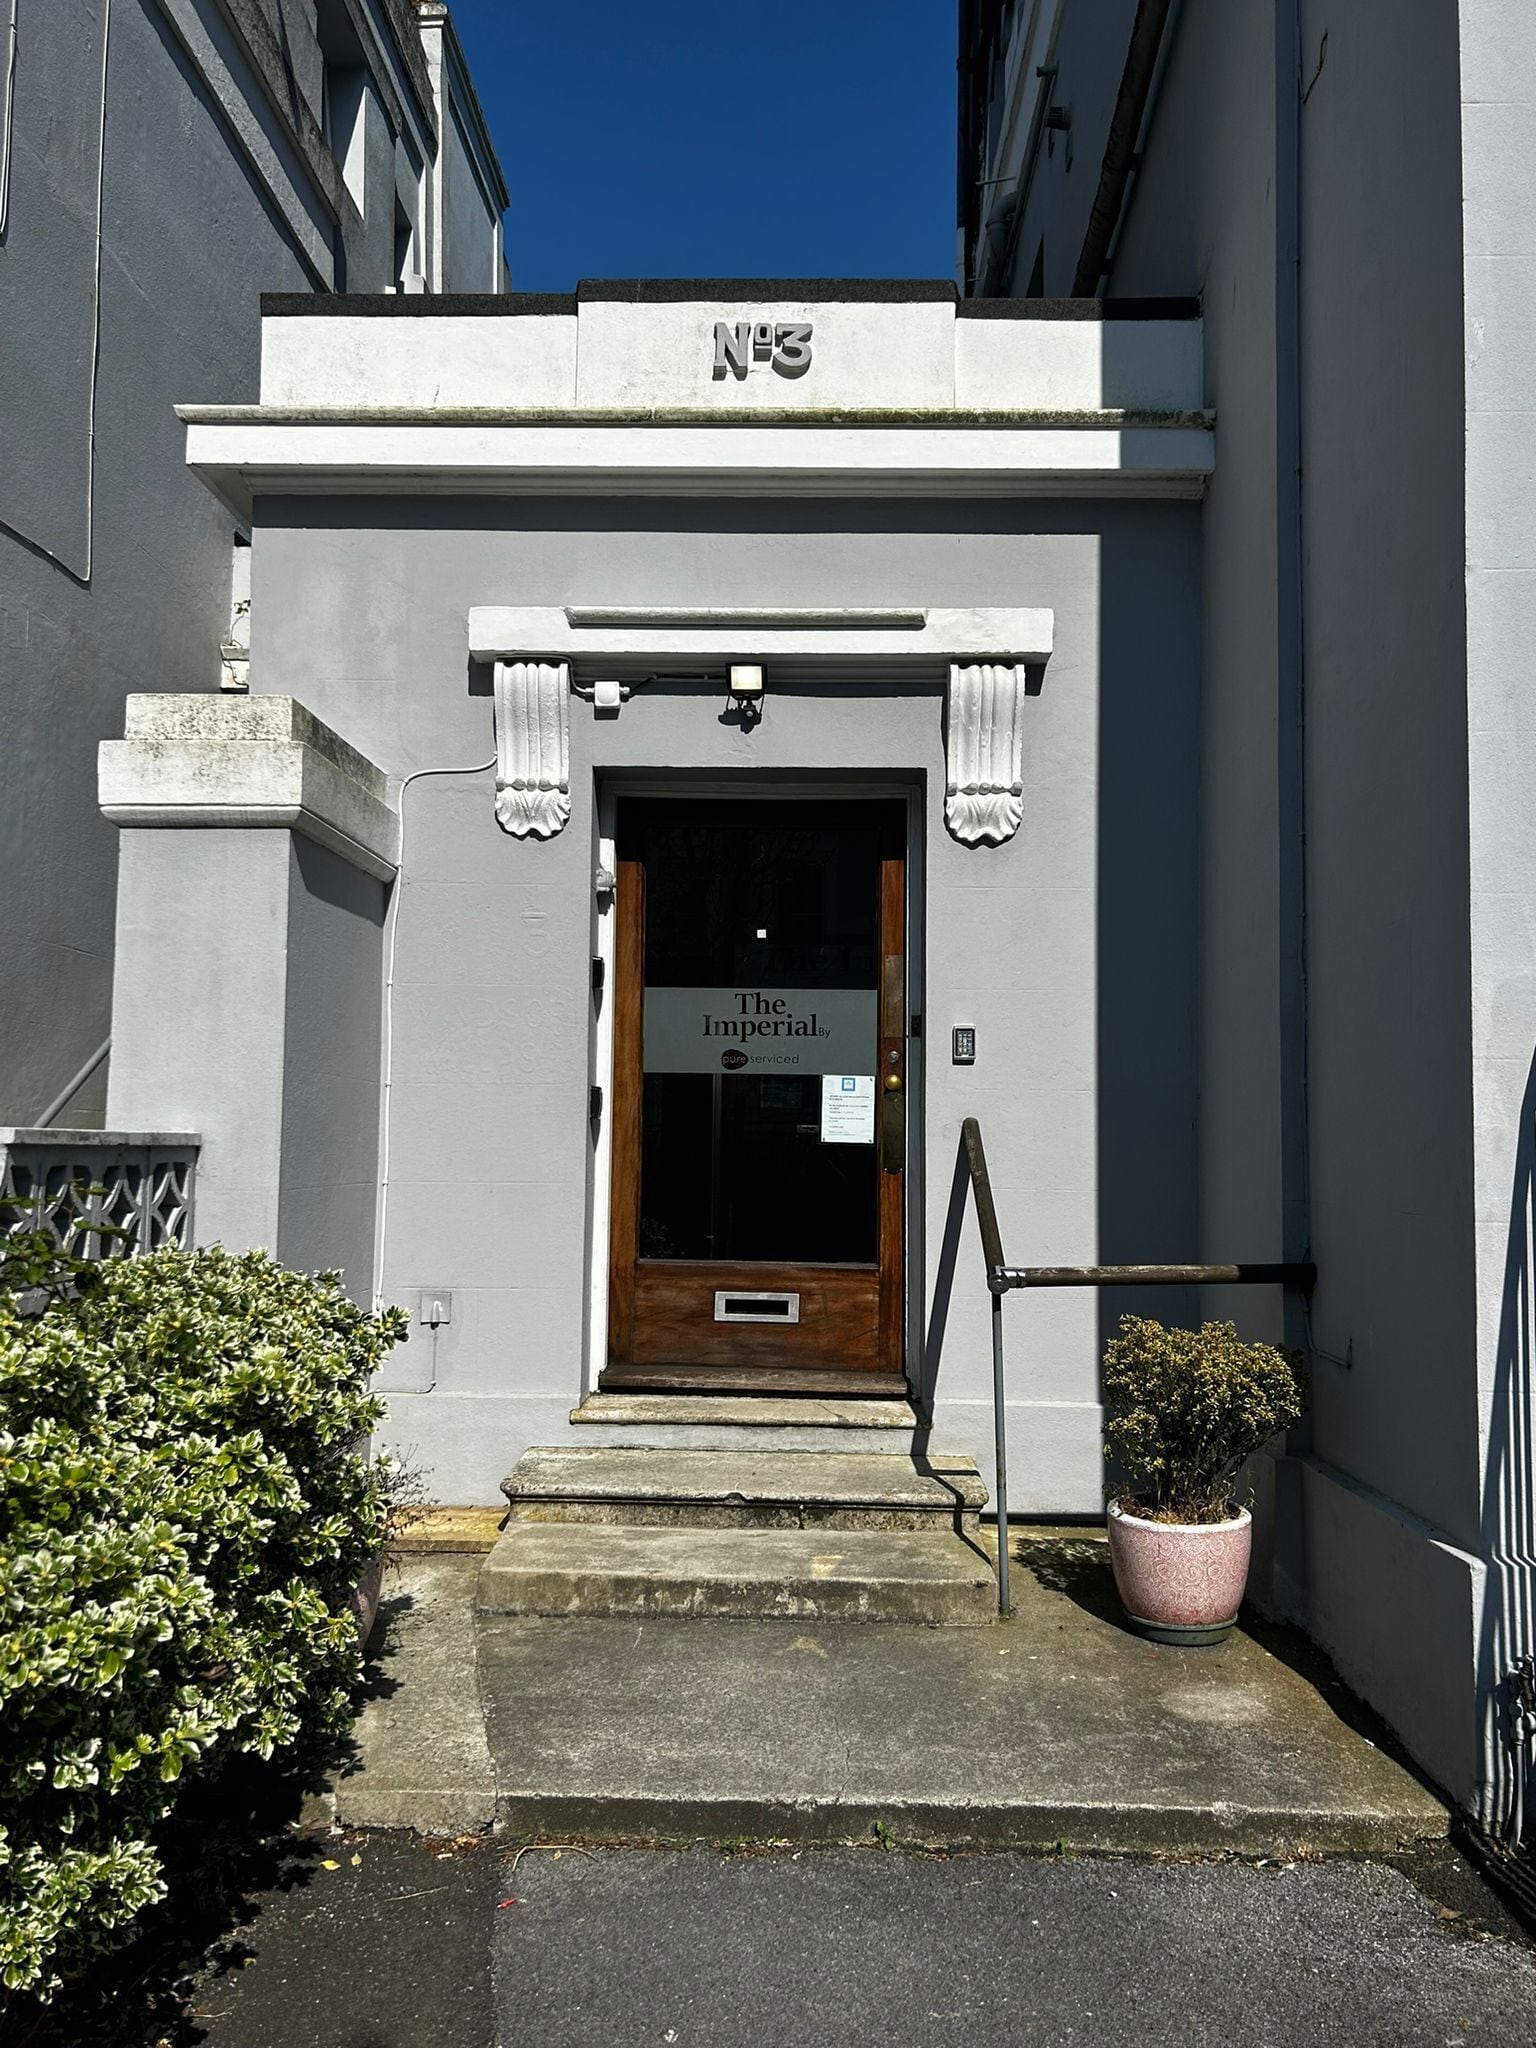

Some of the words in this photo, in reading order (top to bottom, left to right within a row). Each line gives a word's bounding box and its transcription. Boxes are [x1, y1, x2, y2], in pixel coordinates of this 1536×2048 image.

[735, 992, 786, 1015] The
[702, 1014, 818, 1043] Imperial
[818, 1027, 831, 1039] By
[722, 1053, 747, 1066] pure
[749, 1053, 800, 1065] serviced
